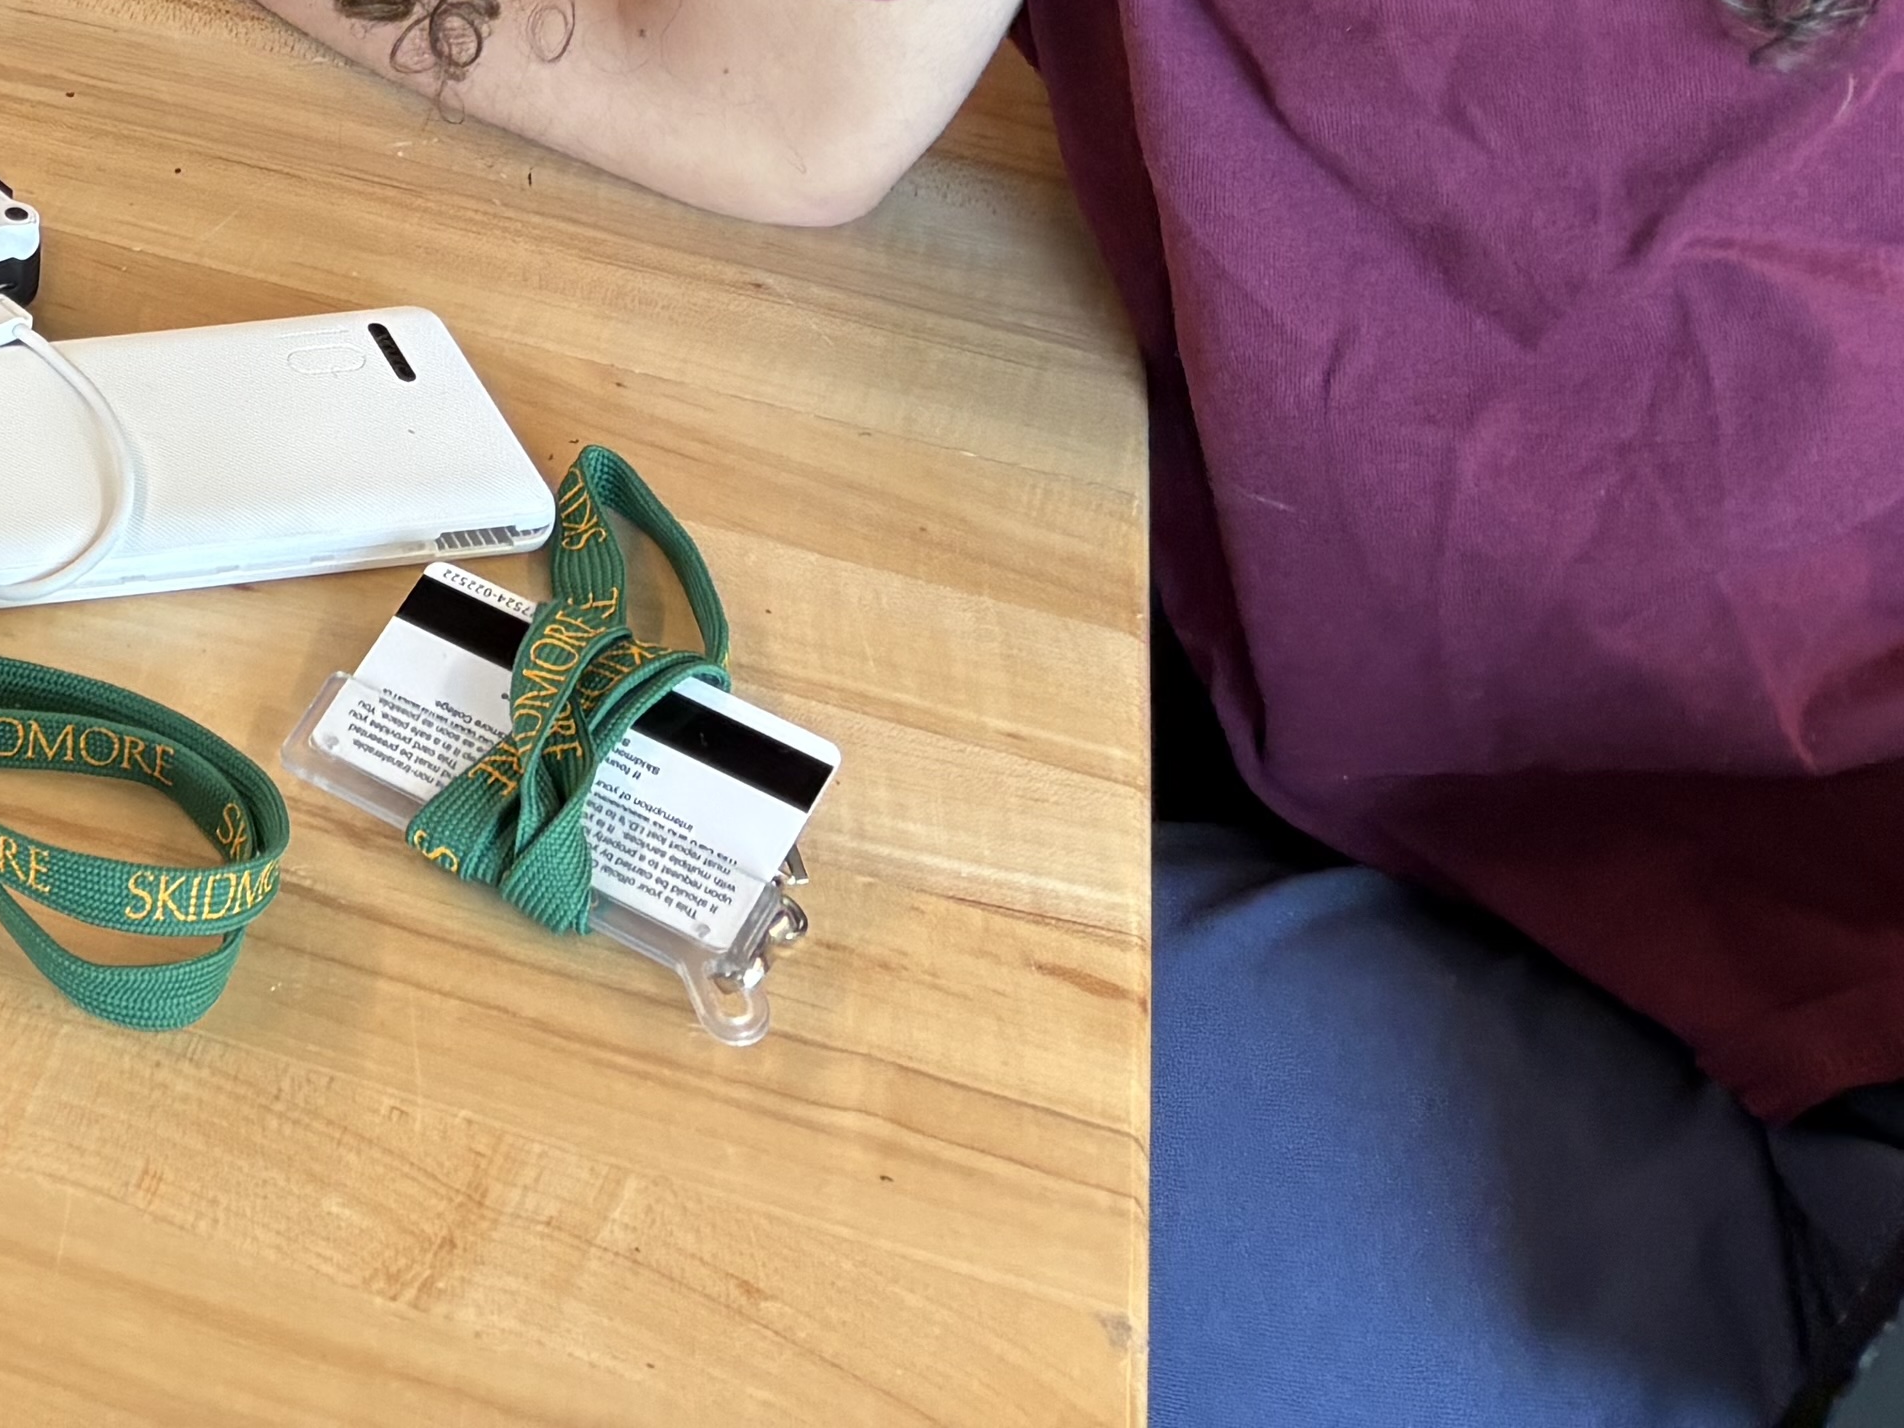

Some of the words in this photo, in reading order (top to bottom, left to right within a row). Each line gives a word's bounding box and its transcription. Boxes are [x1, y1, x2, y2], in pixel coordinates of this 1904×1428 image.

[631, 796, 694, 832] interruption
[598, 863, 636, 887] official
[613, 856, 653, 881] carried
[636, 880, 663, 899] your
[669, 883, 708, 908] should
[673, 901, 698, 918] This
